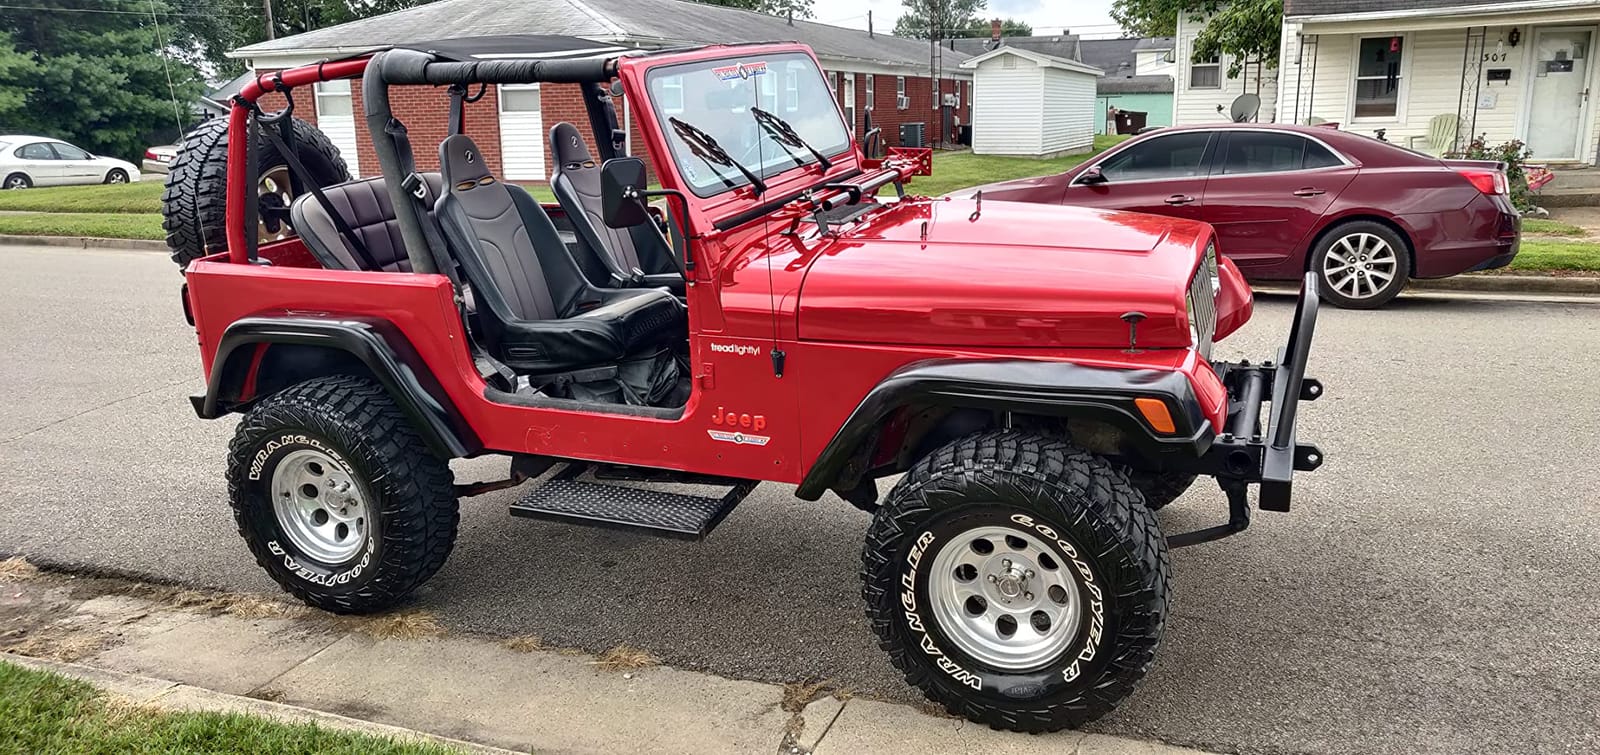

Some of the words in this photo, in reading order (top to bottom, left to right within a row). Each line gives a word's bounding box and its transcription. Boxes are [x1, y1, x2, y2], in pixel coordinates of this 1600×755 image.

[1483, 53, 1507, 62] 307
[712, 406, 766, 431] Jeep
[249, 435, 353, 480] WRANGLER
[268, 537, 375, 586] GOODYEAR
[902, 531, 982, 691] WRANGLER
[1010, 514, 1104, 682] GOODYEAR
